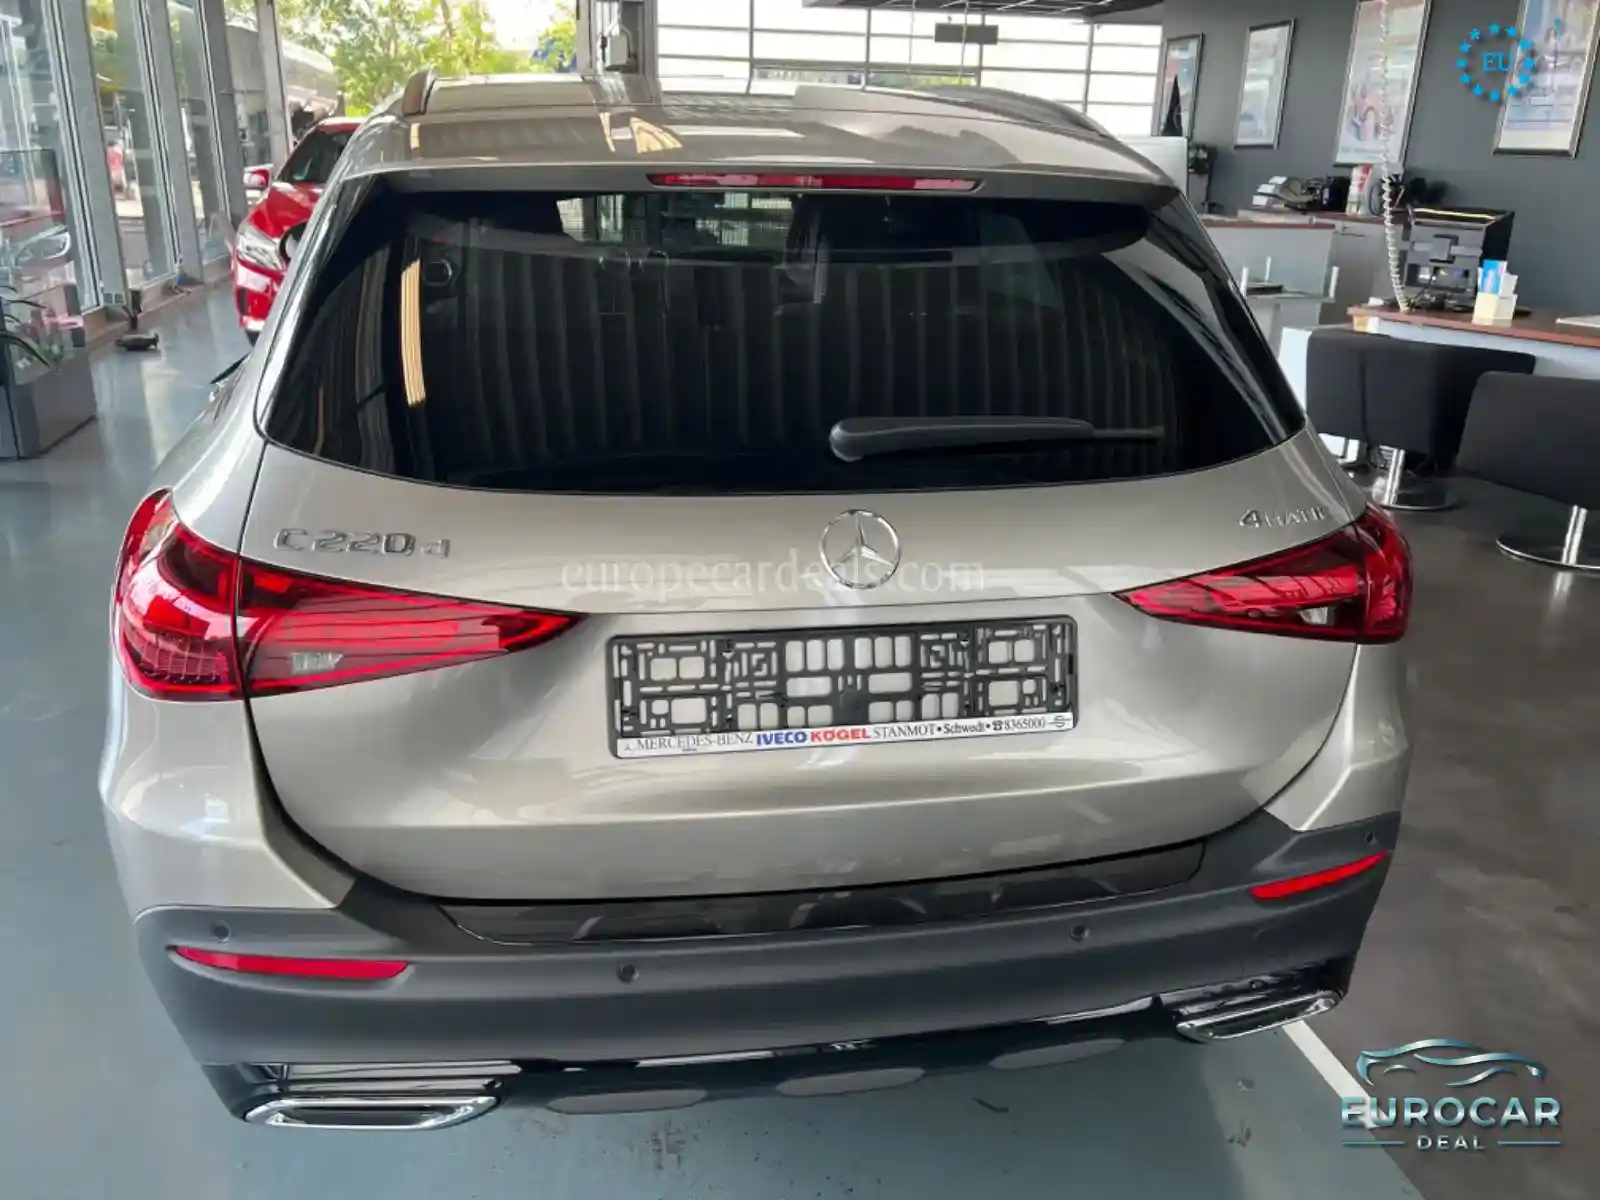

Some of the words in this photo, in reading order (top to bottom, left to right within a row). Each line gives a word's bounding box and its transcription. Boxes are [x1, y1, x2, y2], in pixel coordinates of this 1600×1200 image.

[637, 731, 753, 750] MERCEDES-BENZ
[756, 731, 808, 746] IVECO
[873, 722, 936, 740] STANMOT
